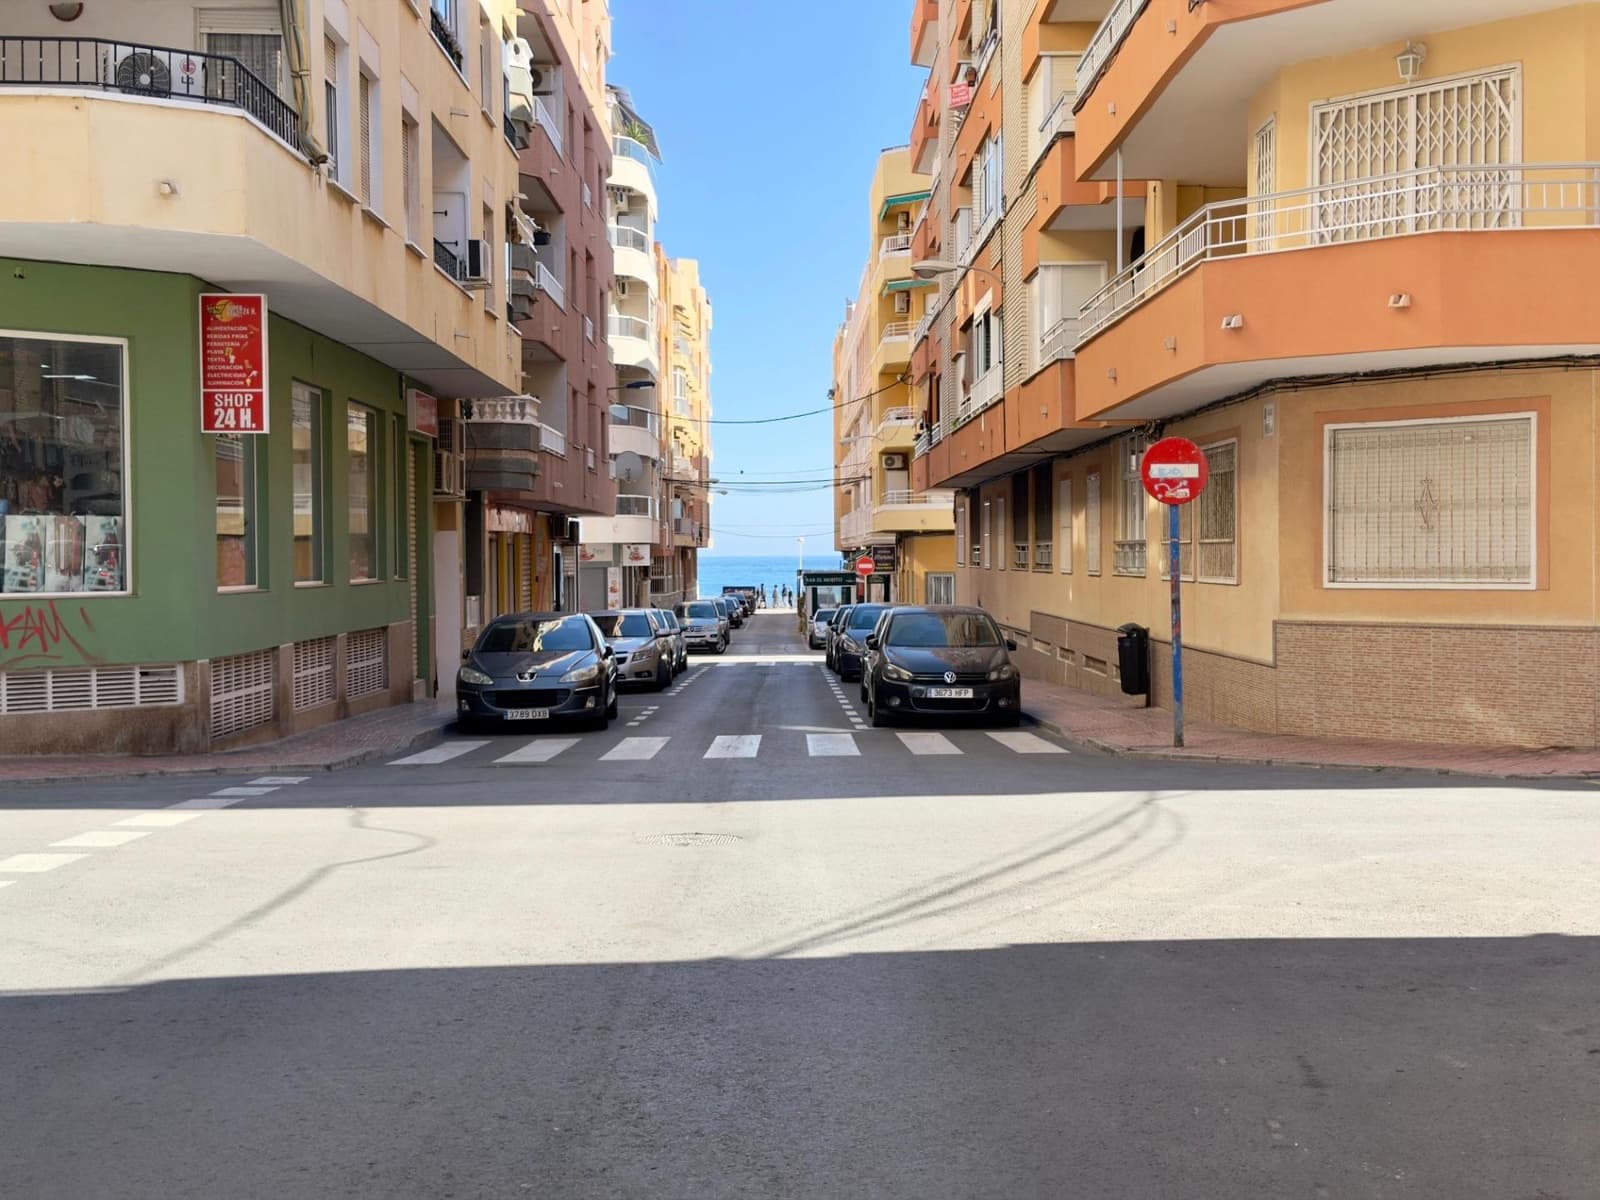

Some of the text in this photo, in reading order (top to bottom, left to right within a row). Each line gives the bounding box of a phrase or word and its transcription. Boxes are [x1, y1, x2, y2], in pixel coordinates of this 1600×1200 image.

[214, 393, 253, 407] SHOP
[214, 408, 236, 429] 24
[934, 688, 952, 697] 3673
